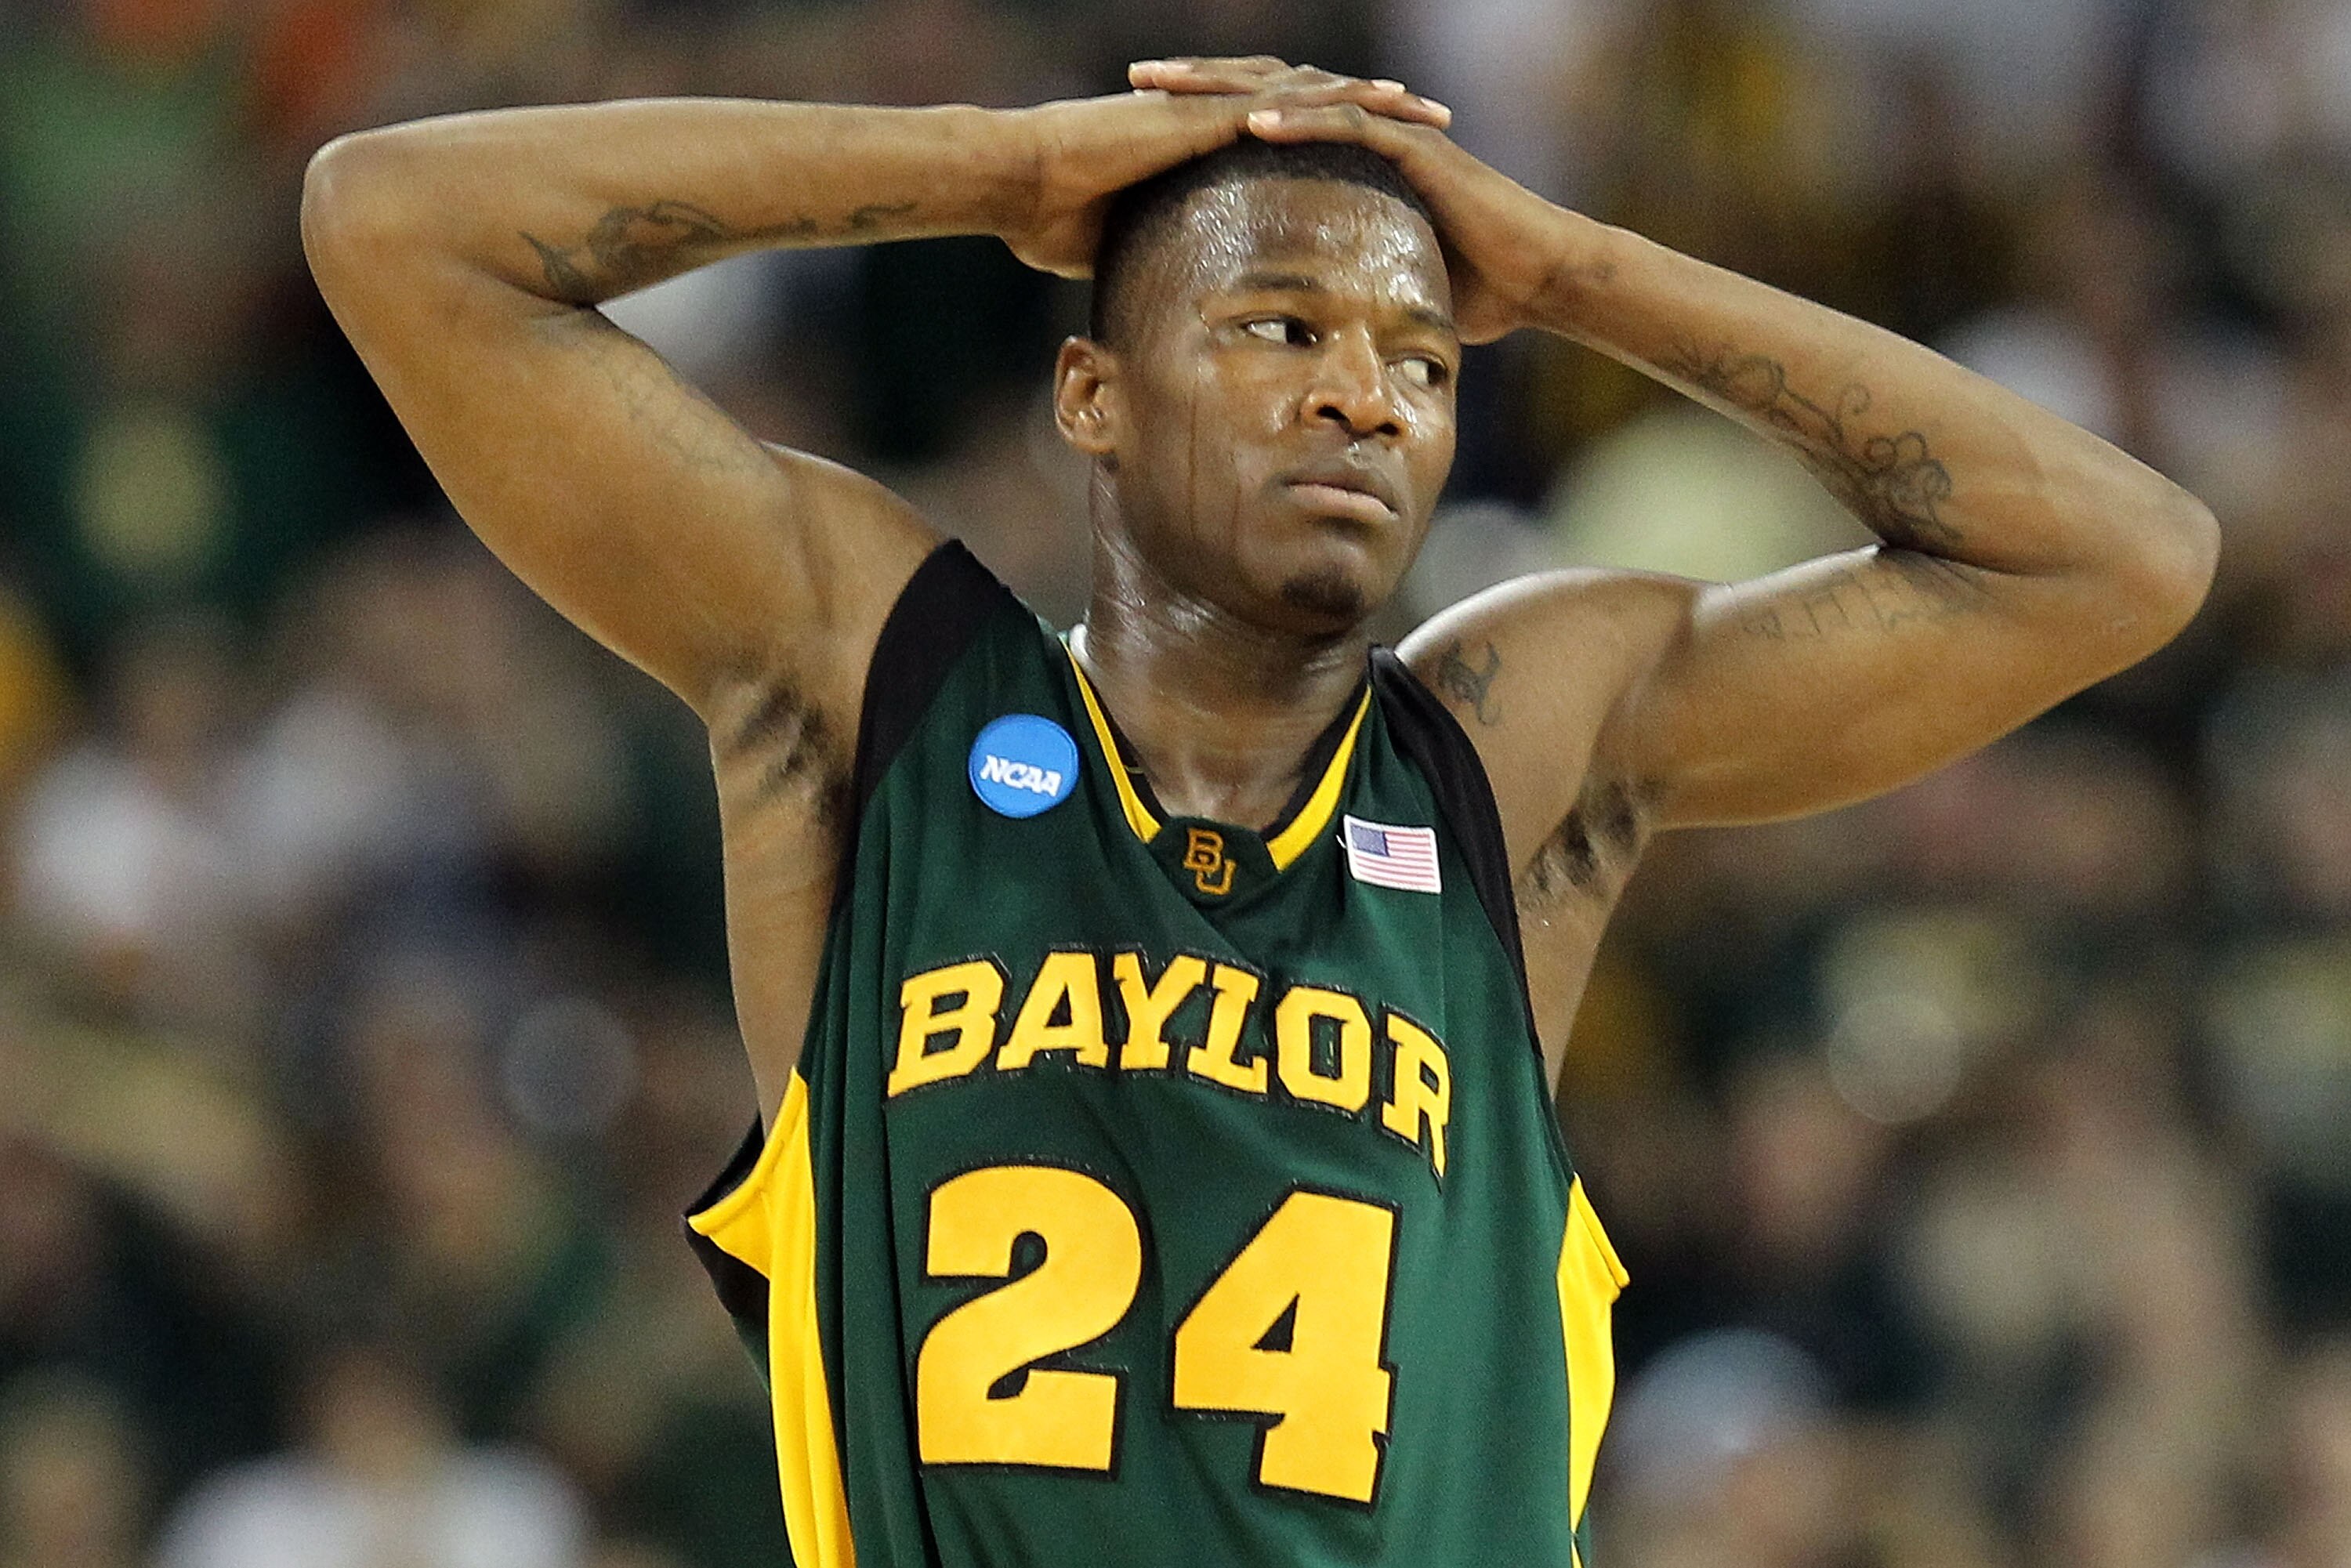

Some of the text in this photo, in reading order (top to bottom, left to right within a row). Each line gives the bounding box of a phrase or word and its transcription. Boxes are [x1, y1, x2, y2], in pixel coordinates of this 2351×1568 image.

[980, 754, 1062, 798] NCAA
[1183, 827, 1236, 895] BU
[884, 947, 1453, 1182] BAYLOR
[915, 1161, 1401, 1509] 24
